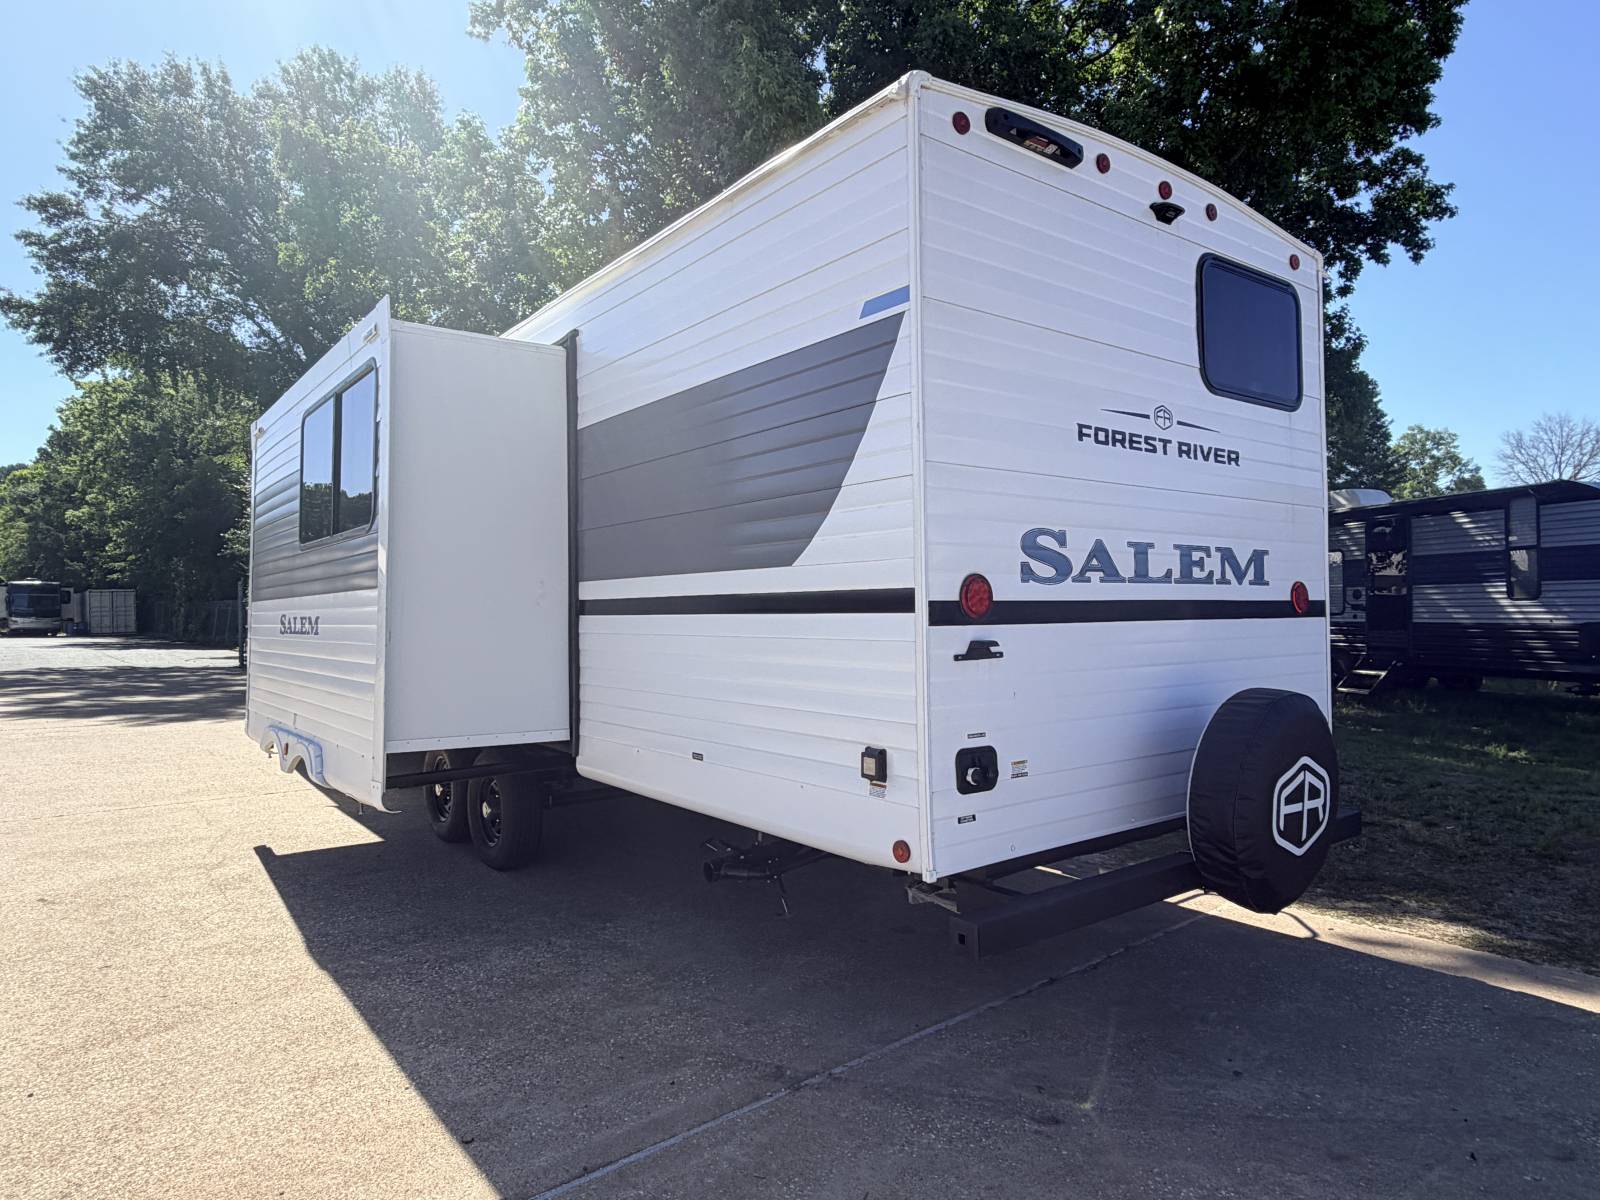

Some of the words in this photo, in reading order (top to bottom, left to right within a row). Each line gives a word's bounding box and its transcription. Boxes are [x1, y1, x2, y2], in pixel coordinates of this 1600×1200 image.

[1076, 422, 1172, 456] FOREST
[1177, 441, 1240, 467] RIVER
[1019, 527, 1270, 586] SALEM
[279, 614, 320, 635] SALEM
